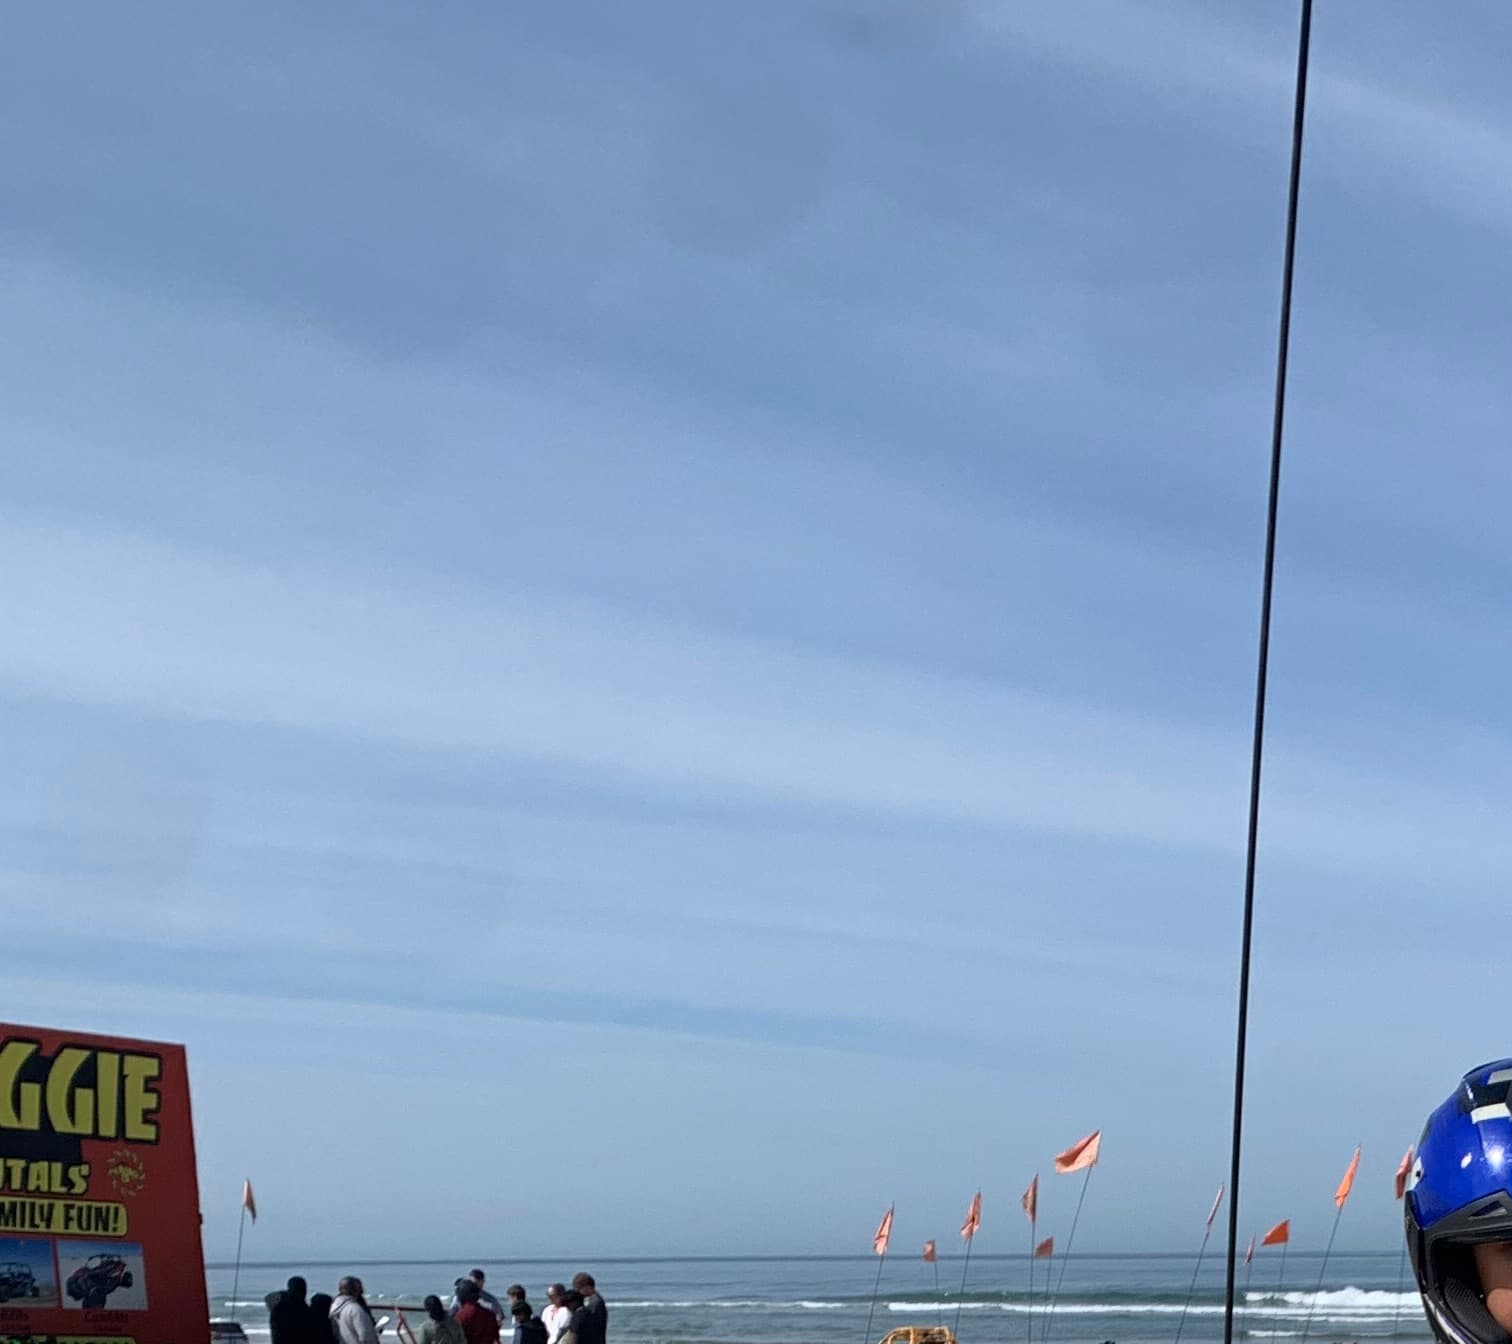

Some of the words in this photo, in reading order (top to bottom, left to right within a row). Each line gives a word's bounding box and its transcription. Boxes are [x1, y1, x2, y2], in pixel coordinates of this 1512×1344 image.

[0, 1041, 161, 1141] GGIE
[0, 1157, 90, 1194] TALS
[63, 1203, 120, 1234] FUN!
